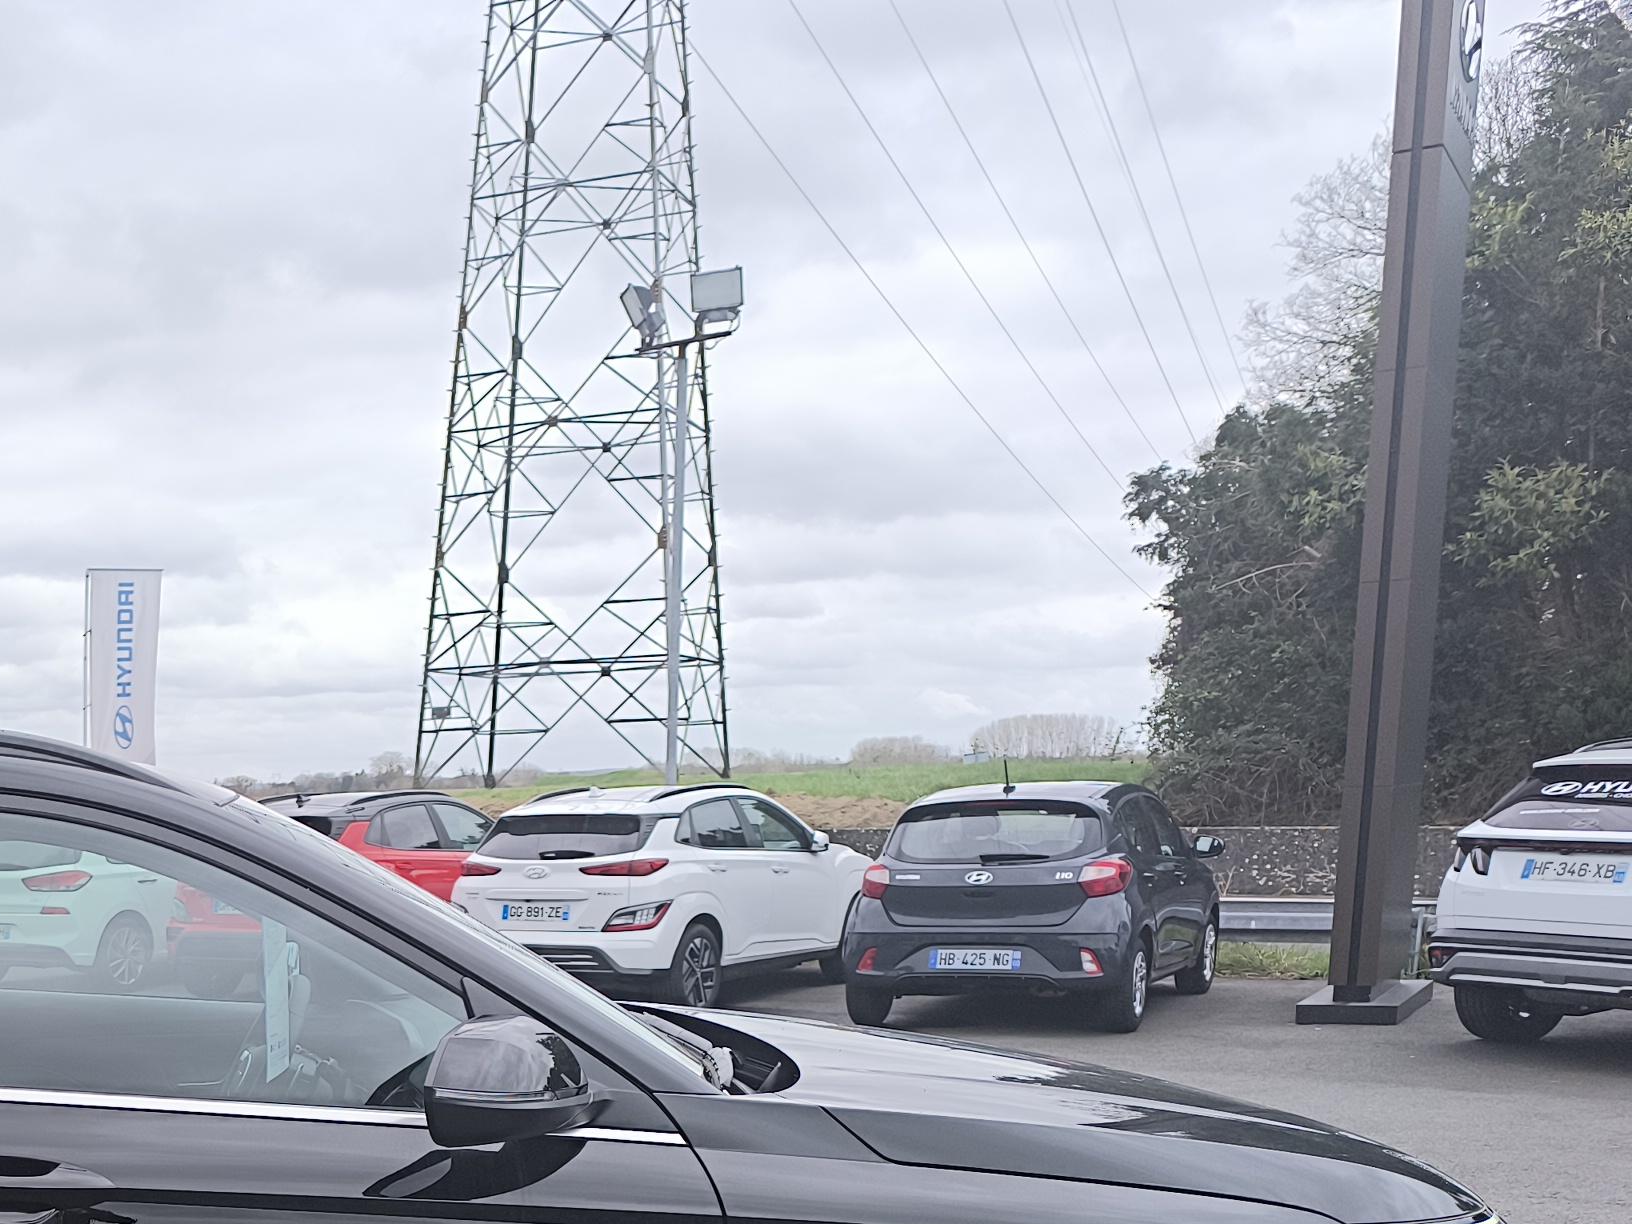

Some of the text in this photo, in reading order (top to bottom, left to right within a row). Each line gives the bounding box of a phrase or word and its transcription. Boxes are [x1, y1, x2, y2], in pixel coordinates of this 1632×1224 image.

[116, 582, 135, 698] HYUNDAI
[1531, 861, 1617, 879] HF-346-XB
[509, 906, 563, 918] GG-891-ZE
[939, 952, 1010, 966] HB-425-NG
